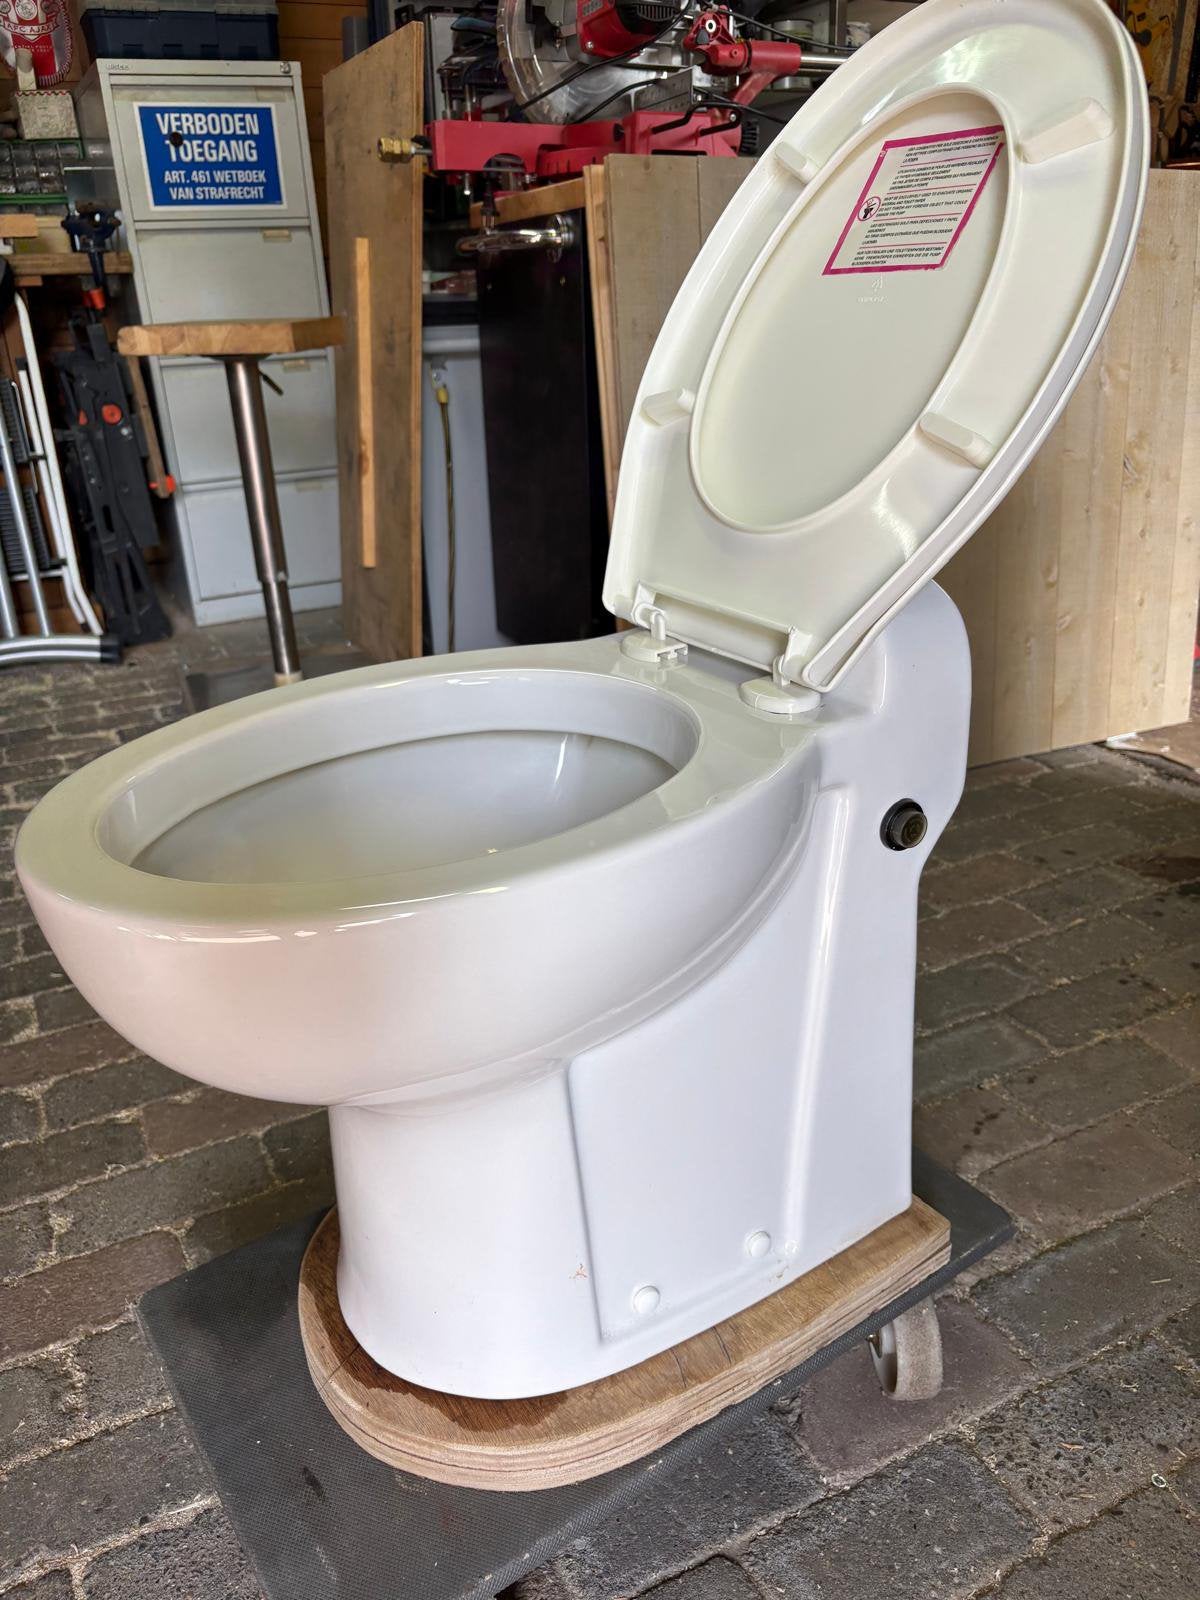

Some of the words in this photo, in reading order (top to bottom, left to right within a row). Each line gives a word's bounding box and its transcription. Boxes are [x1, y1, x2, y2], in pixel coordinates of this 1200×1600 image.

[156, 112, 260, 136] VERBODEN
[165, 139, 258, 163] TOEGANG
[164, 170, 190, 184] ART.
[191, 170, 210, 184] 461
[213, 169, 267, 183] WETBOEK
[169, 187, 195, 201] VAN
[196, 186, 265, 200] STRAFRECHT
